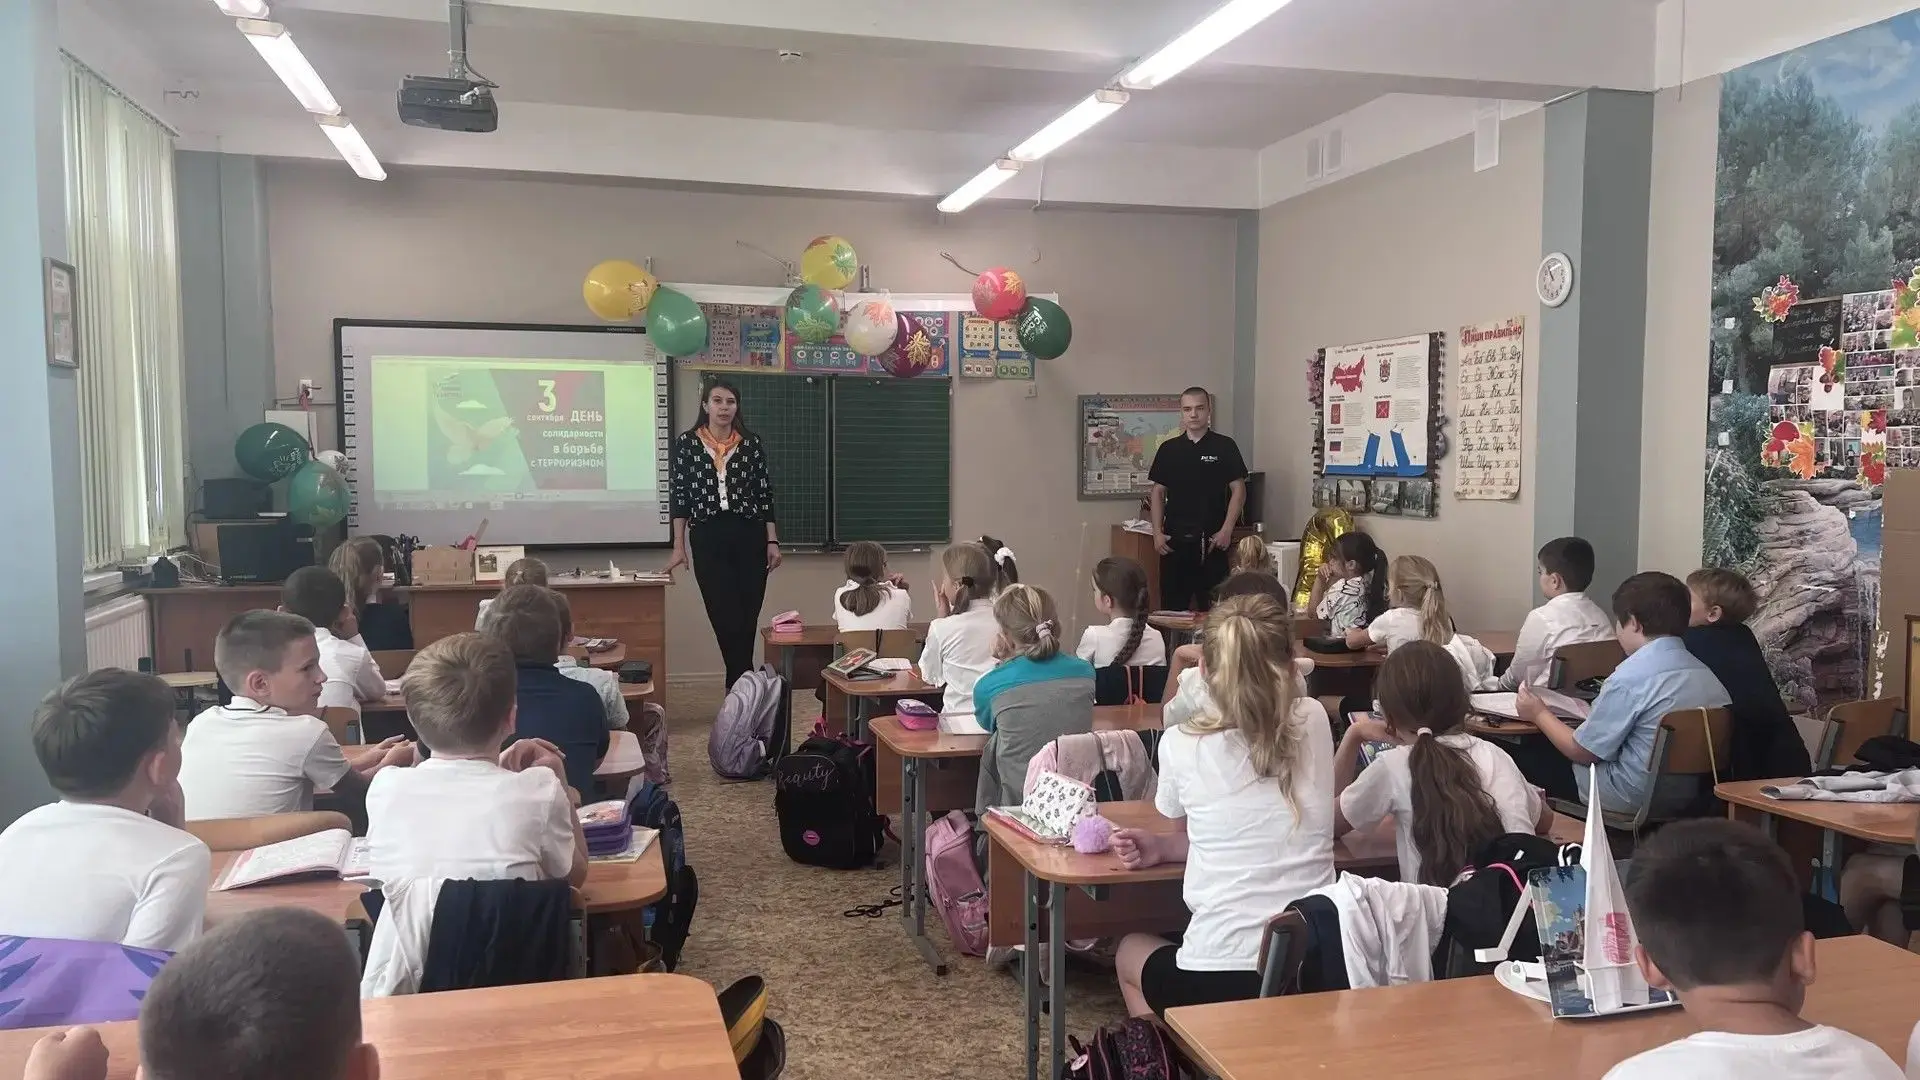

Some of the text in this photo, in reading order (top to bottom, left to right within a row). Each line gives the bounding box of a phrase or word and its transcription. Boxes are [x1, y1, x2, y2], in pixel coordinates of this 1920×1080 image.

[538, 379, 557, 413] 3
[526, 413, 564, 423] сентября
[570, 409, 603, 424] ДЕНЬ
[542, 429, 604, 439] солидарности
[553, 442, 604, 455] в борьбе
[538, 458, 604, 468] ТЕРРОРИЗМОМ
